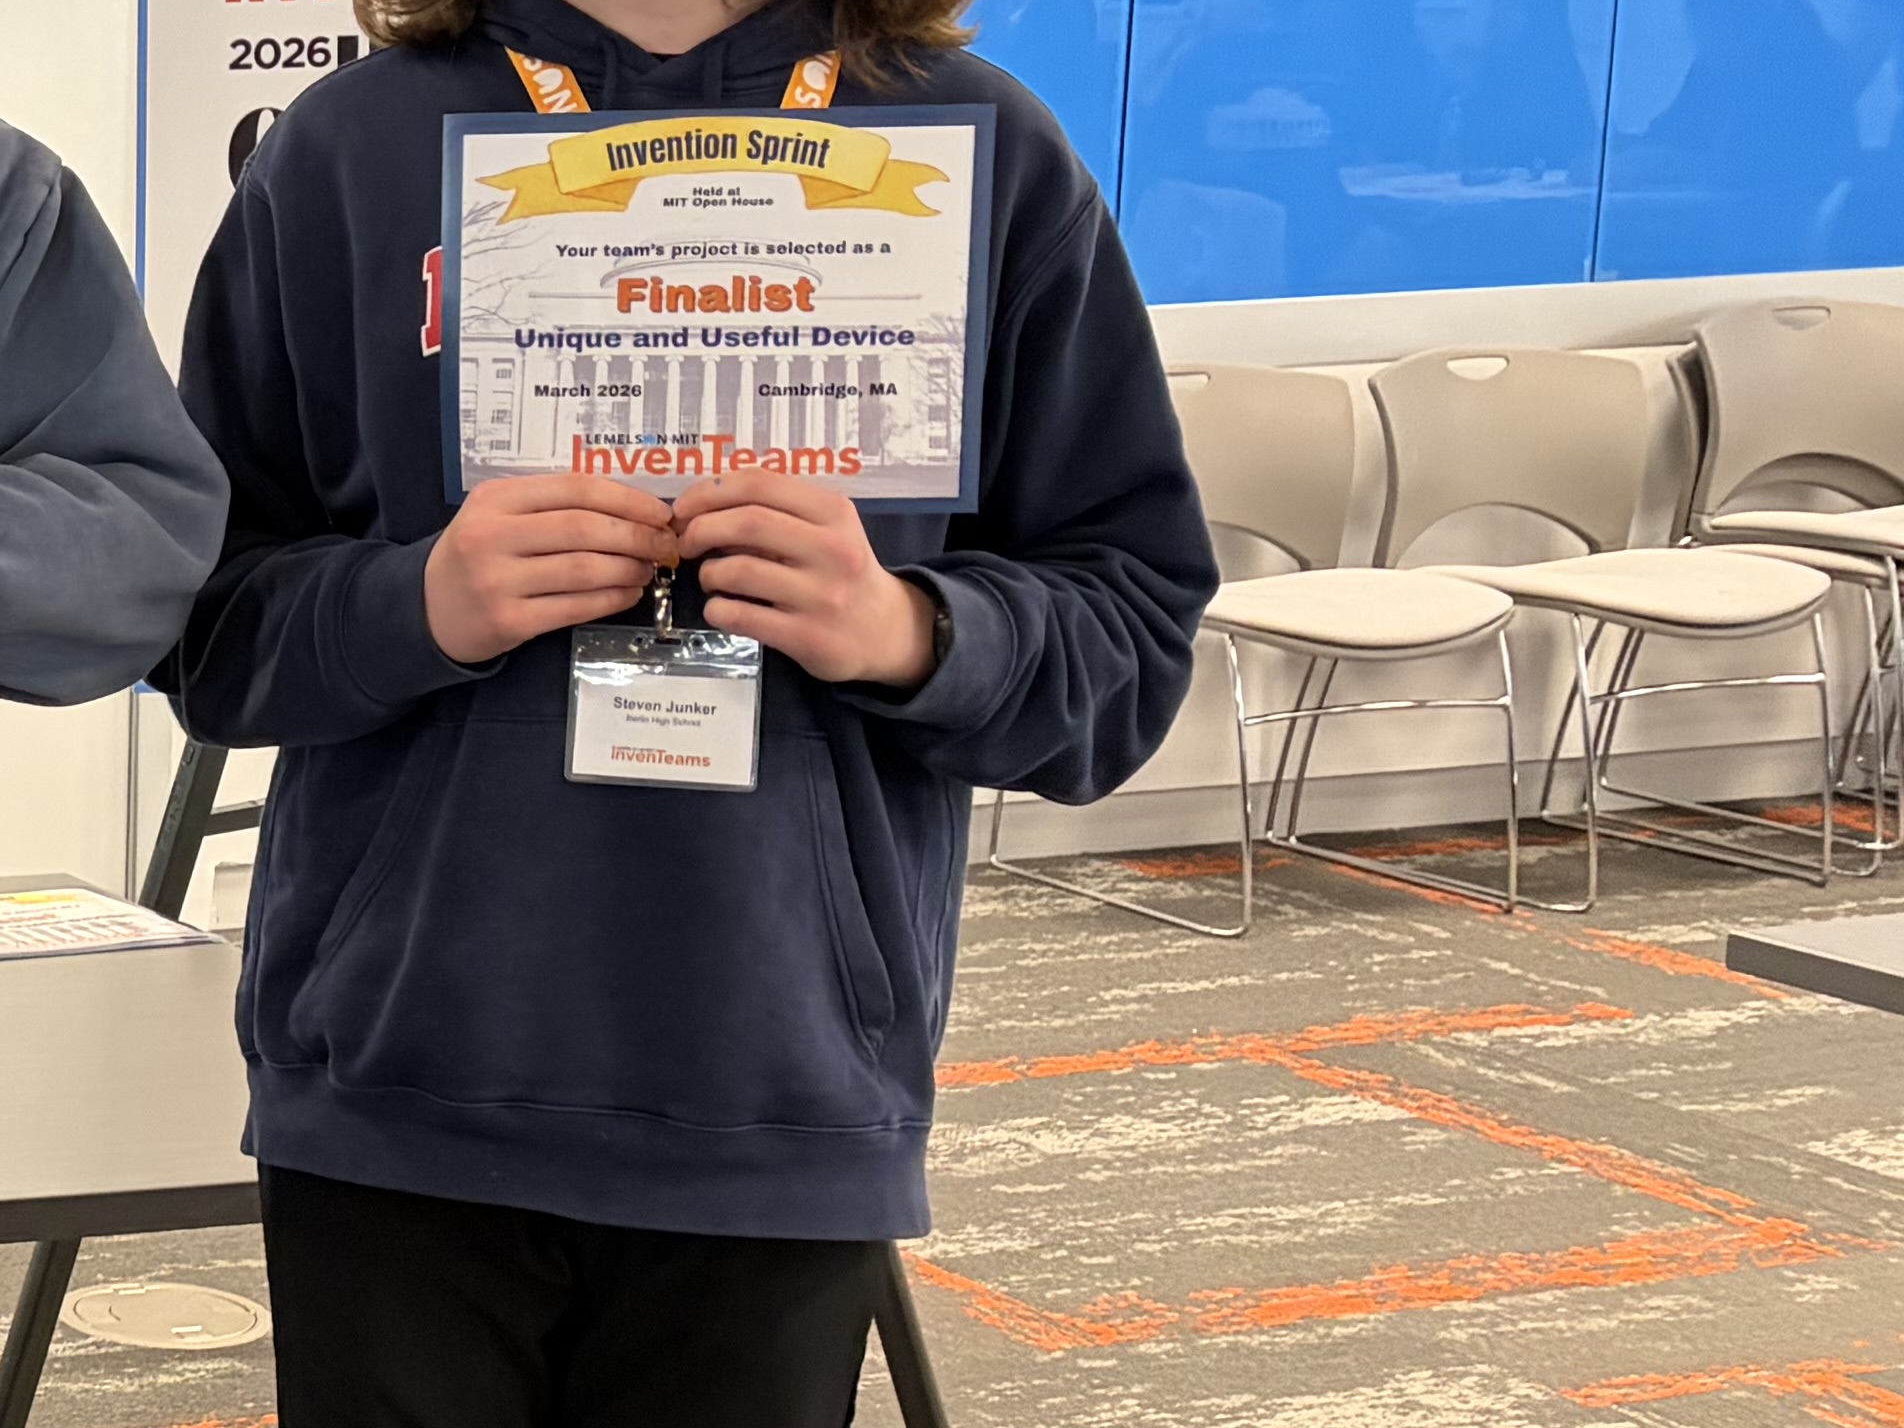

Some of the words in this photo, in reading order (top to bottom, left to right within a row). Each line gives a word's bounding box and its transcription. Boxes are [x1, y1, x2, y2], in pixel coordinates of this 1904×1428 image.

[229, 37, 331, 70] 2026
[606, 129, 737, 172] Invention
[746, 130, 831, 169] Sprint
[692, 187, 723, 196] Held
[727, 187, 740, 196] at
[663, 197, 688, 207] MIT
[692, 197, 727, 208] Open
[732, 197, 774, 206] House
[556, 244, 597, 258] Your
[604, 244, 665, 257] team's
[671, 243, 737, 259] project
[744, 243, 759, 255] is
[766, 241, 846, 255] selected
[852, 243, 873, 254] as
[880, 243, 891, 254] a
[617, 275, 816, 313] Finalist
[514, 328, 622, 353] Unique
[632, 327, 689, 347] and
[702, 326, 799, 347] Useful
[811, 325, 915, 347] Device
[534, 384, 590, 398] March
[597, 384, 642, 398] 2026
[758, 383, 863, 399] Cambridge,
[869, 384, 898, 396] MA
[571, 434, 862, 476] InvenTeams
[614, 697, 661, 711] Steven
[666, 701, 717, 715] Junker
[611, 746, 710, 767] InvenTeams
